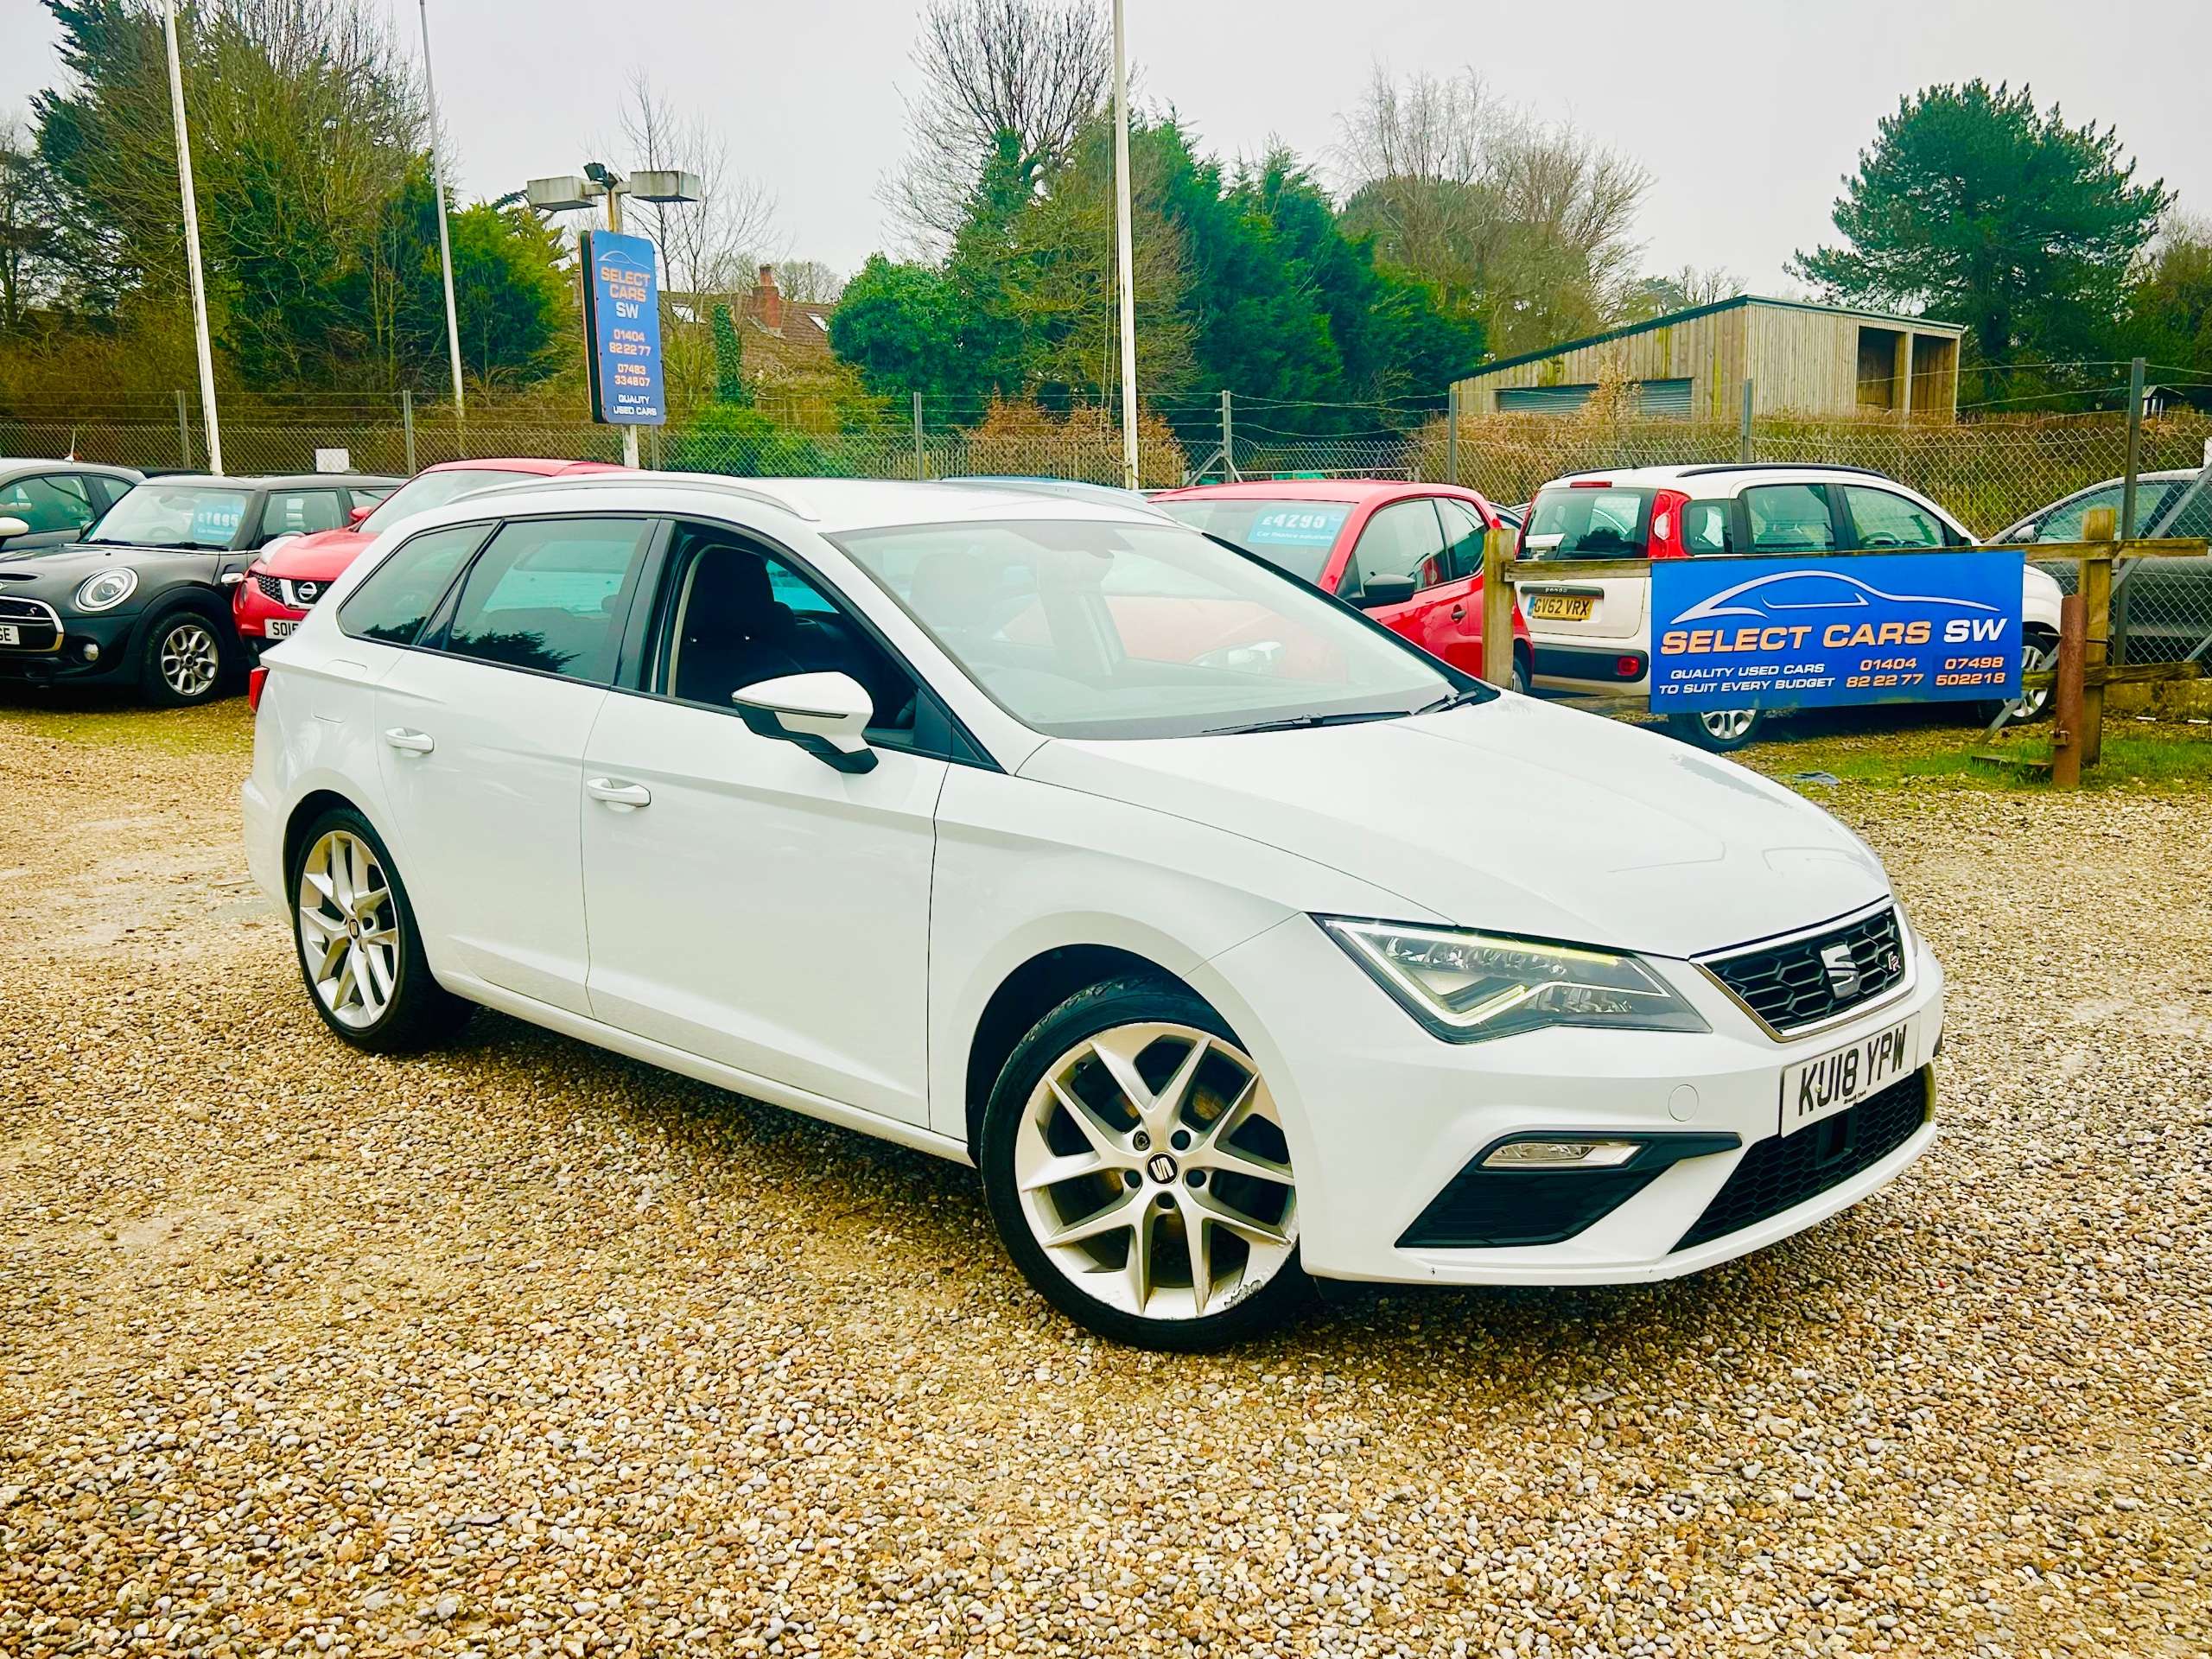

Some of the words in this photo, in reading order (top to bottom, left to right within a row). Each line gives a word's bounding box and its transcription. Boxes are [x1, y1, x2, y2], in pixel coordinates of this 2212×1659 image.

[601, 266, 651, 287] SELECT
[610, 284, 646, 303] CARS
[615, 302, 639, 319] SW
[613, 329, 645, 342] 01404
[618, 394, 650, 404] QUALITY
[613, 406, 634, 415] USED
[635, 407, 657, 416] CARS
[1534, 598, 1563, 614] GV62
[1566, 599, 1590, 616] VRX
[1660, 626, 1813, 655] SELECT
[1822, 620, 1932, 648] CARS
[1943, 618, 2007, 643] SW
[1859, 658, 1917, 671] 01404
[1944, 657, 2005, 670] 07498
[1670, 667, 1735, 680] QUALITY
[1738, 665, 1779, 677] USED
[1783, 664, 1825, 675] CARS
[1936, 672, 2006, 686] 502218
[1659, 684, 1680, 695] TO
[1682, 682, 1718, 694] SUIT
[1720, 680, 1771, 692] EVERY
[1774, 677, 1835, 690] BUDGET
[1798, 1047, 1859, 1117] KU18
[1866, 1023, 1907, 1087] YPW
